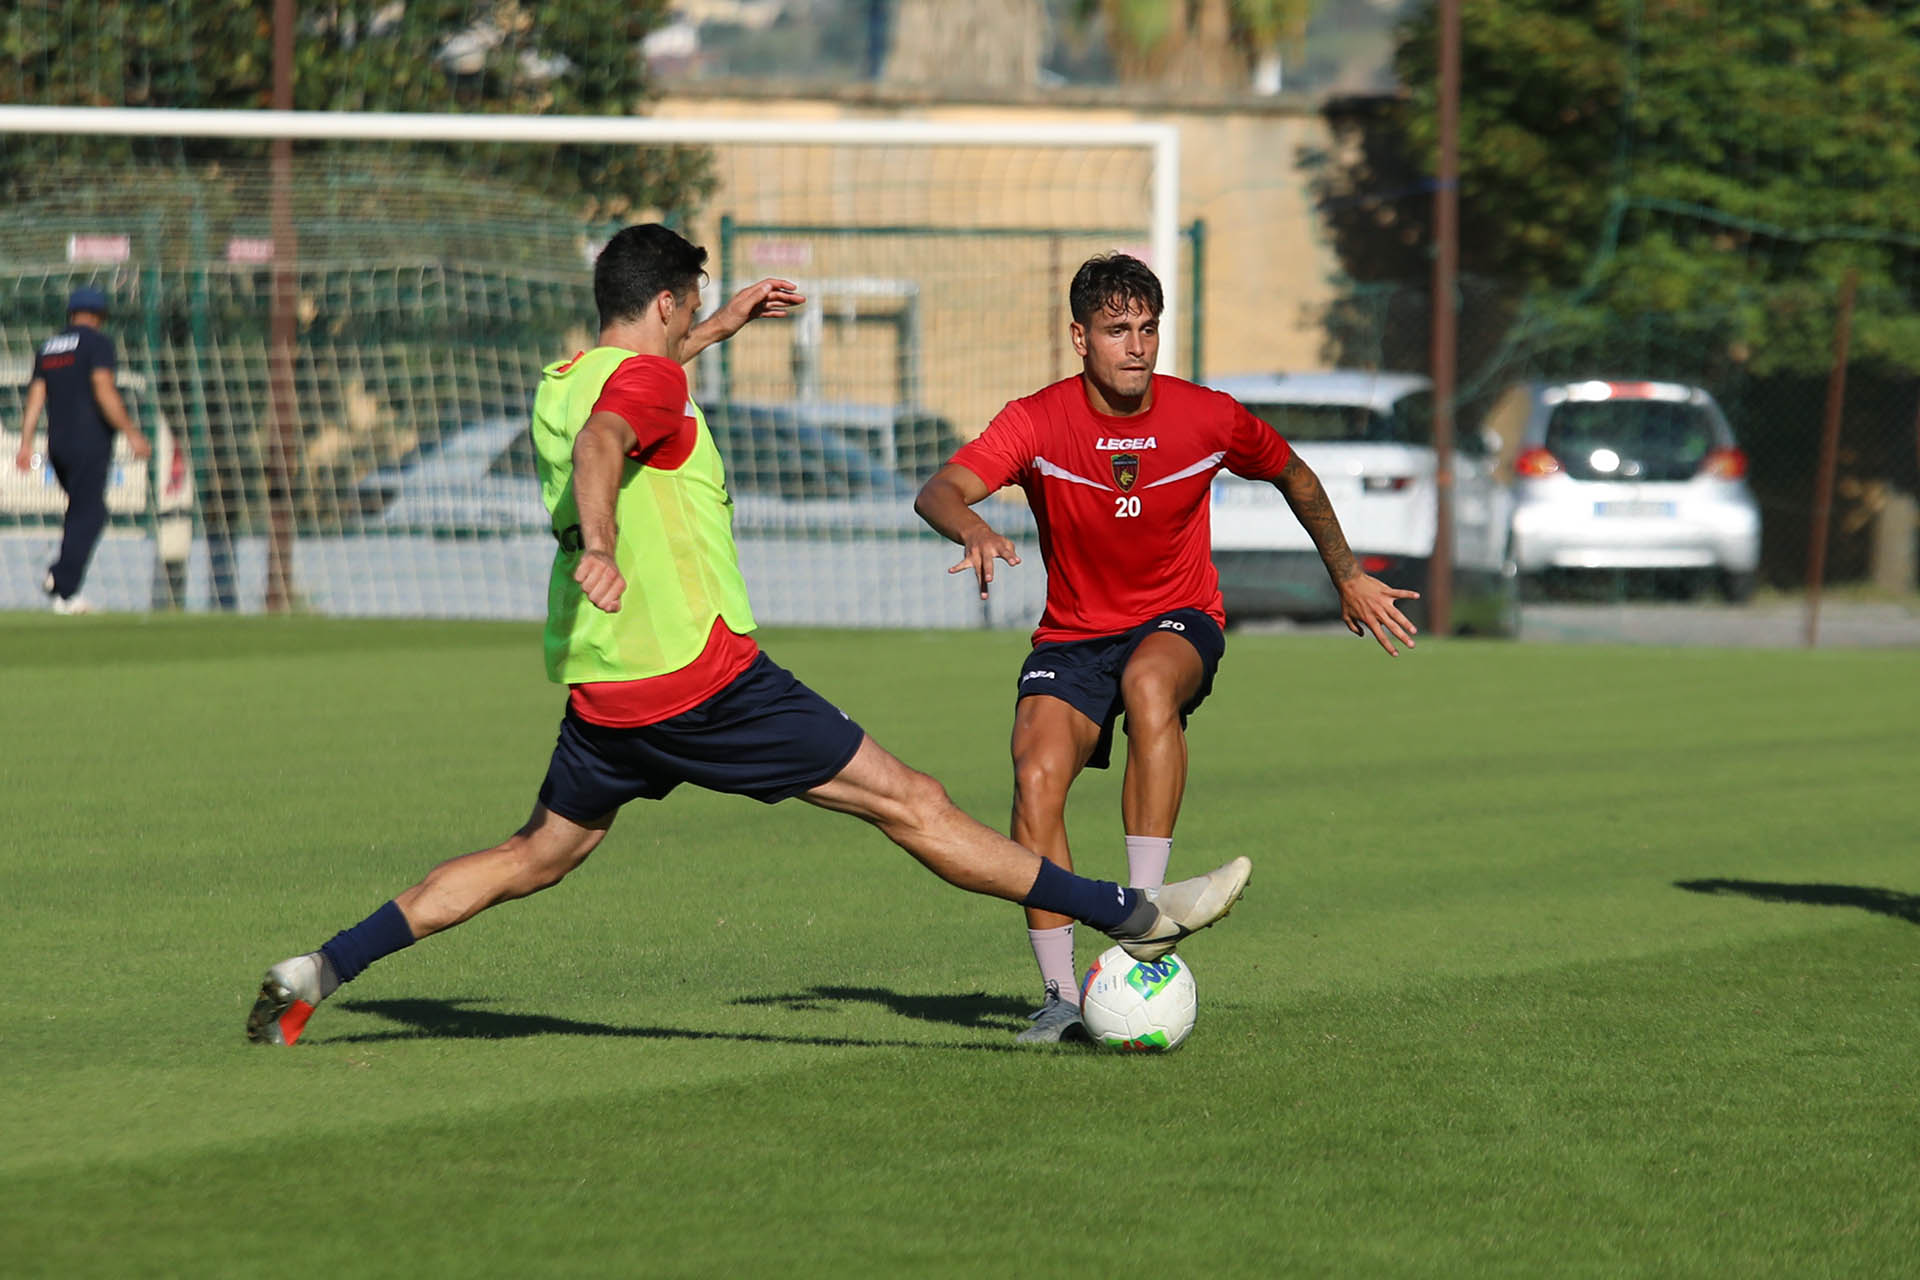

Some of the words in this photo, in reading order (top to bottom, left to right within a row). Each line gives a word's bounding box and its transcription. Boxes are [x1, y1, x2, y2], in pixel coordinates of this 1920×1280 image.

[1096, 436, 1157, 450] LEGEA
[1115, 496, 1141, 517] 20
[1158, 620, 1185, 631] 20
